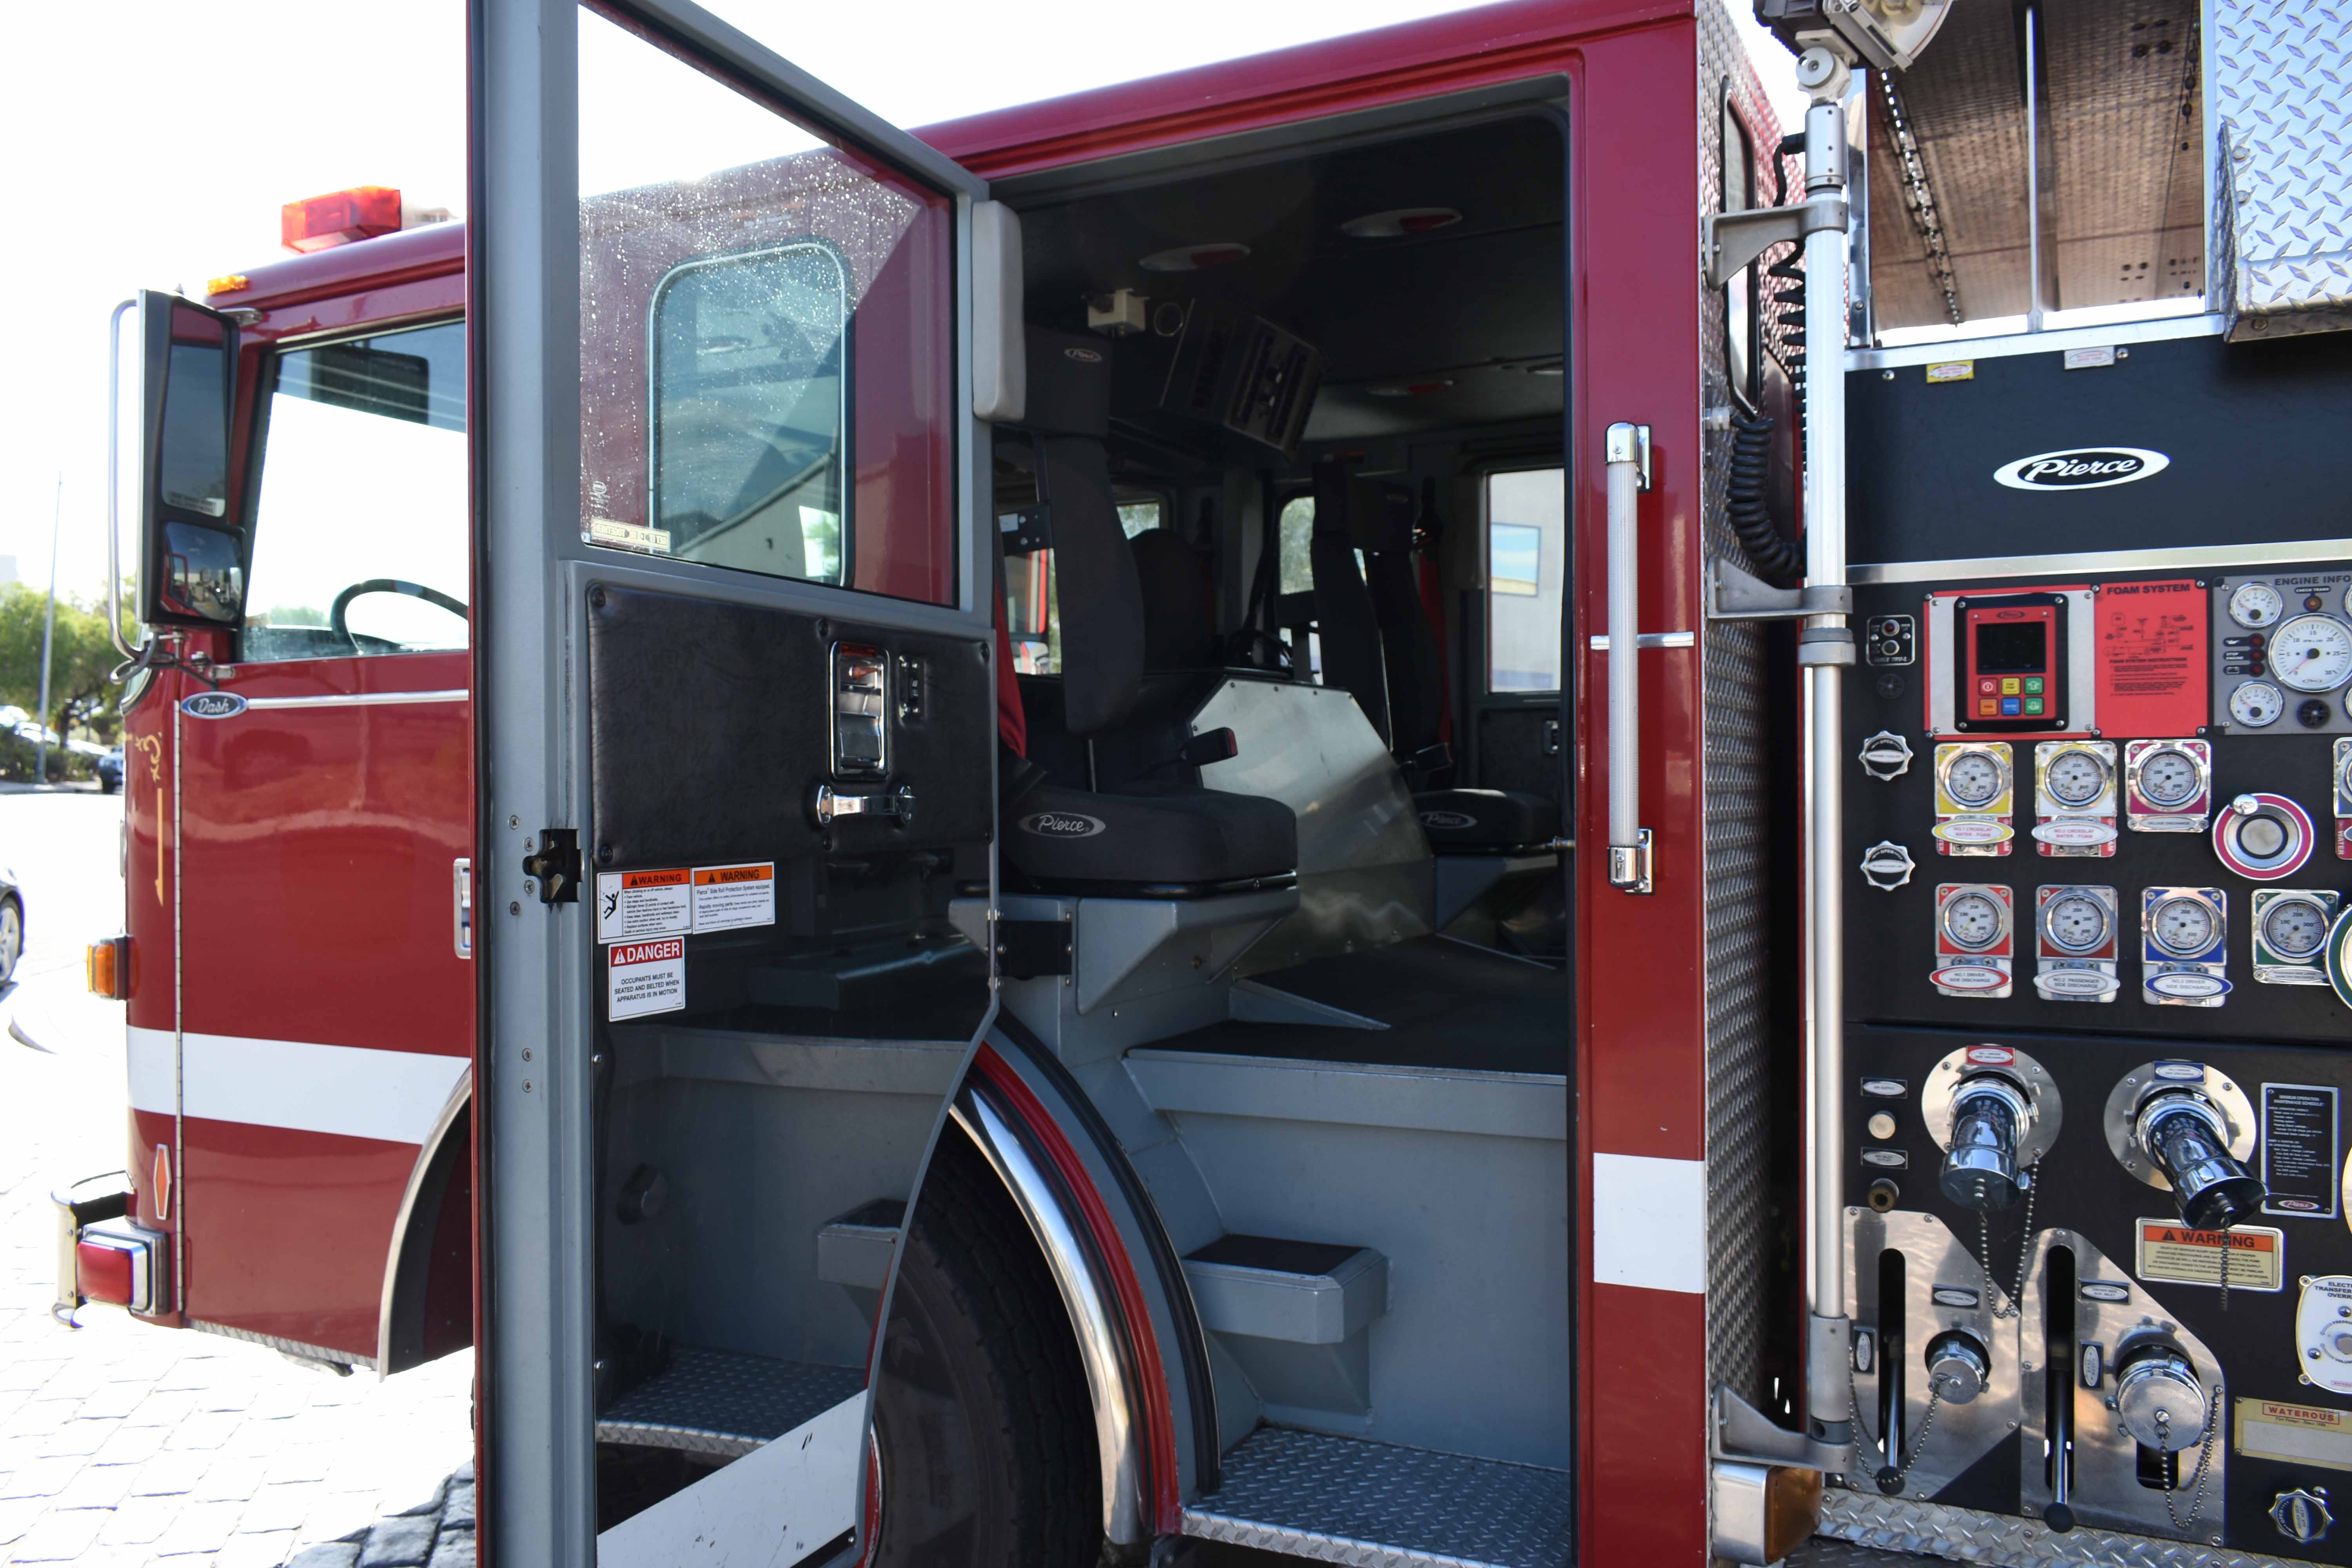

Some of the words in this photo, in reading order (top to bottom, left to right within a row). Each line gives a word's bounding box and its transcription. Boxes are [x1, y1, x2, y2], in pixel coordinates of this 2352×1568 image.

[2024, 459, 2138, 481] Pierce
[2275, 577, 2319, 585] ENGINE
[2107, 586, 2140, 595] FOAM
[2143, 583, 2190, 593] SYSTEM
[198, 698, 230, 713] Dash
[1039, 815, 1084, 832] Pierce
[639, 874, 682, 884] WARNING
[720, 869, 760, 882] WARNING
[627, 942, 680, 962] DANGER
[621, 975, 651, 985] OCCUPANTS
[615, 986, 633, 995] SEATED
[617, 993, 646, 1003] APPARATUS
[2269, 1406, 2334, 1421] WATEROUS
